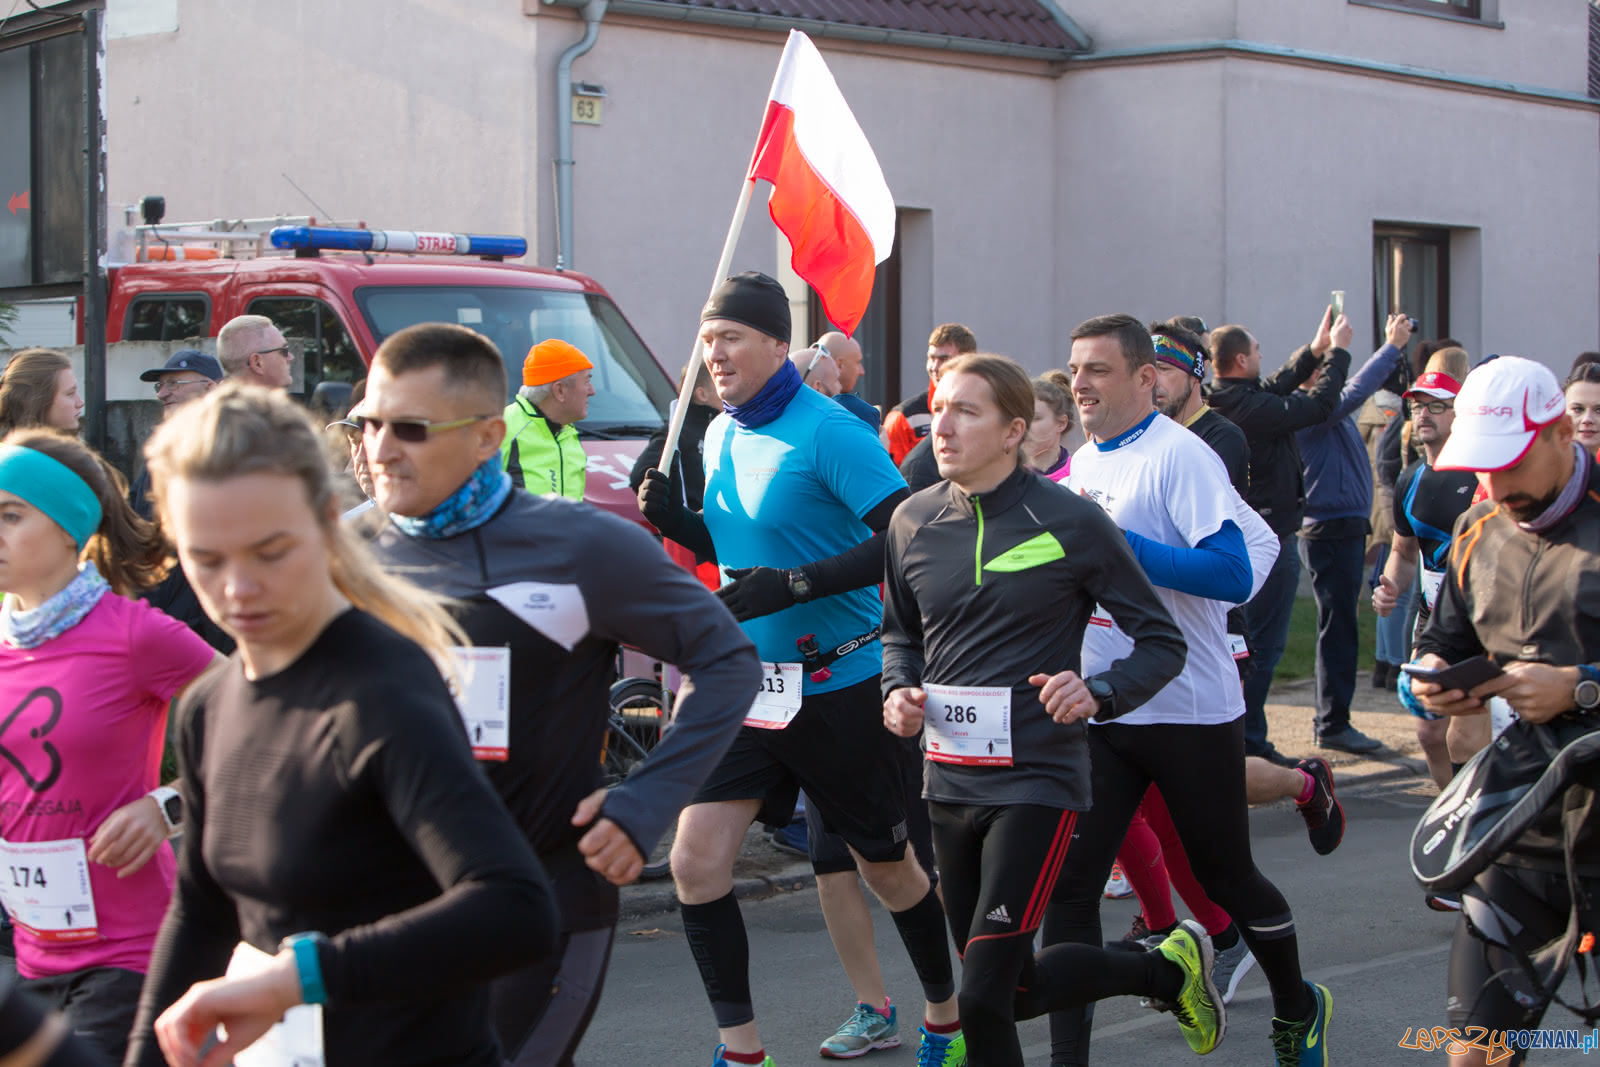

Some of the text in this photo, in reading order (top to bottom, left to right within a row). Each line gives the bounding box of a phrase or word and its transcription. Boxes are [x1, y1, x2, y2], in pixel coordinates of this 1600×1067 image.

[576, 101, 594, 119] 63
[944, 704, 977, 724] 286
[10, 866, 47, 888] 174
[986, 913, 1012, 924] adidas
